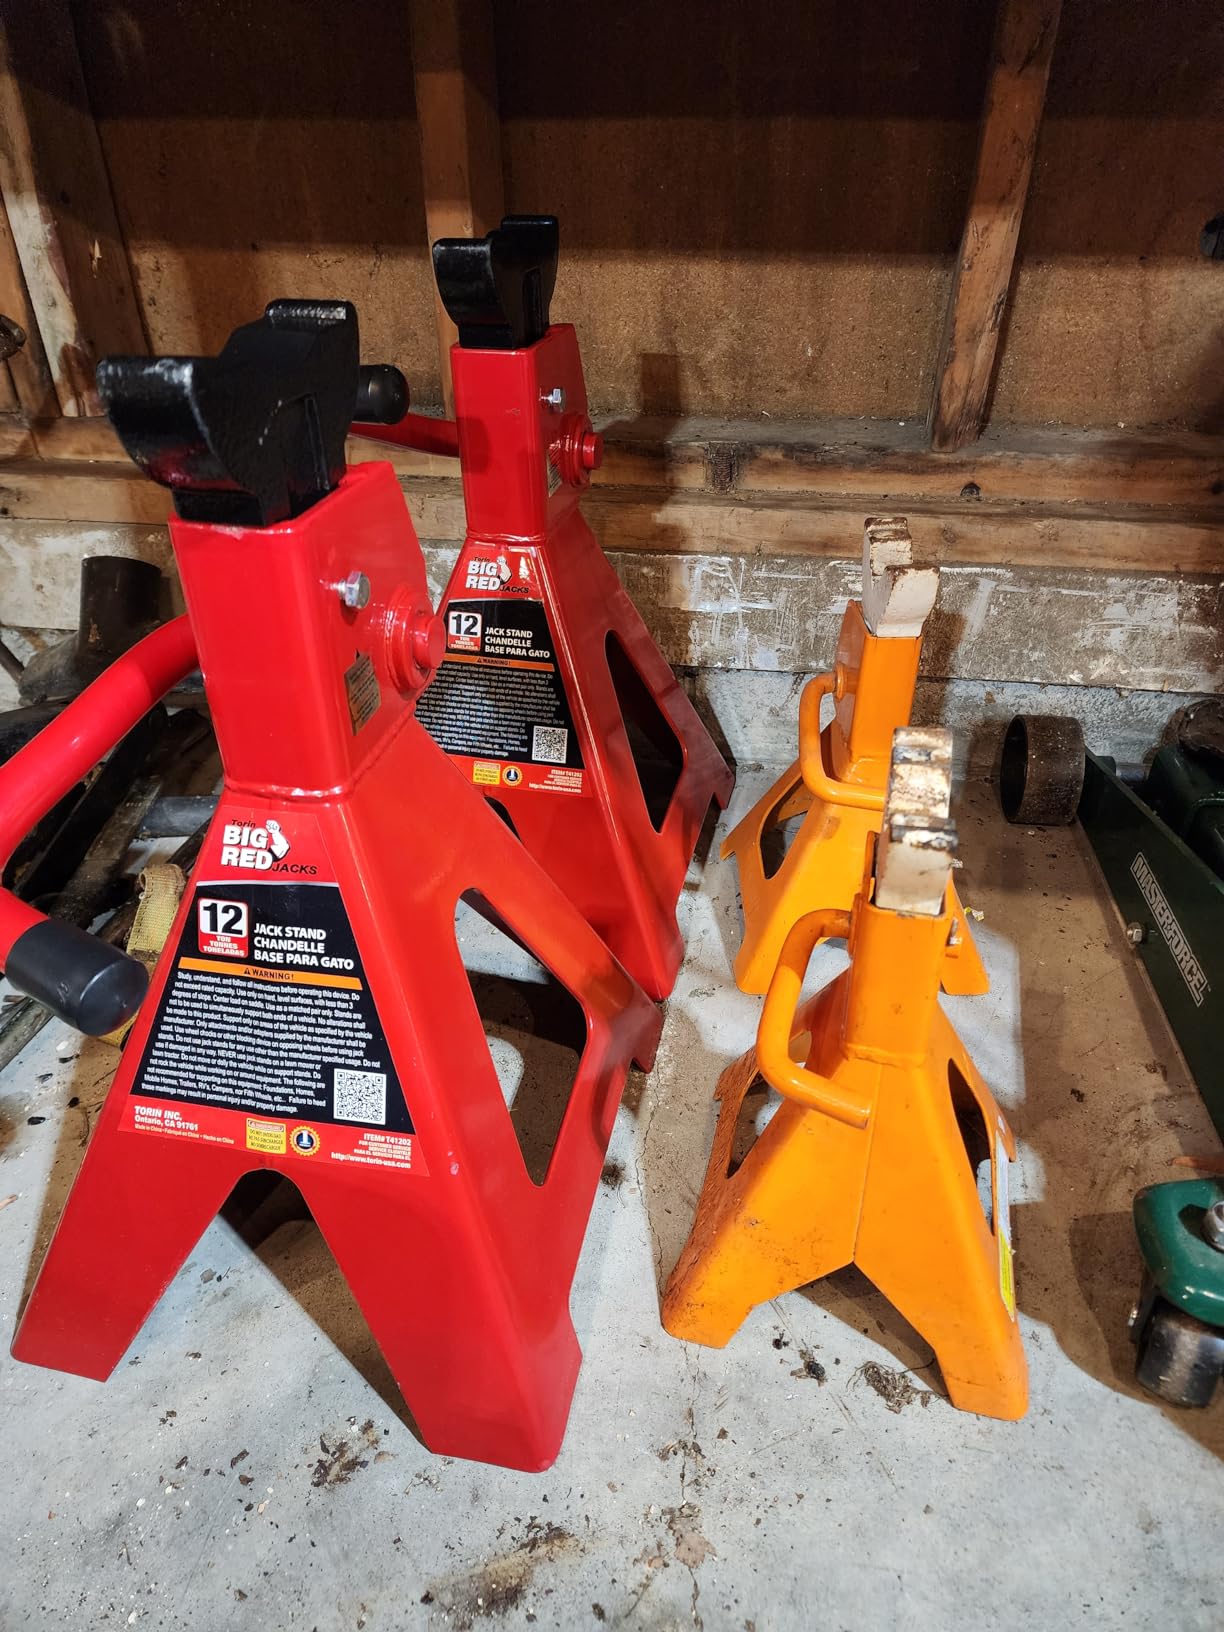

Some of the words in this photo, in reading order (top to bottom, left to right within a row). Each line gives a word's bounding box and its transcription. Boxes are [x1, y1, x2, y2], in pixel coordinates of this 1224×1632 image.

[468, 560, 498, 576] BIG
[466, 576, 501, 591] RED
[452, 614, 478, 636] 12
[485, 626, 505, 636] JACK
[506, 629, 533, 638] STAND
[485, 636, 532, 648] CHANDELLE
[484, 645, 505, 654] BASE
[506, 648, 526, 656] PARA
[528, 650, 550, 658] GATO
[231, 819, 256, 828] Torin
[223, 825, 268, 850] BIG
[221, 846, 273, 870] RED
[272, 864, 318, 875] JACKS
[203, 902, 243, 936] 12
[254, 922, 283, 936] JACK
[284, 926, 326, 940] STAND
[1133, 856, 1206, 1003] MASTERFORCE
[203, 946, 244, 956] TONELADAS
[210, 940, 238, 950] TONNES
[254, 936, 325, 954] CHANDELLE
[254, 950, 284, 964] BASE
[286, 954, 318, 966] PARA
[320, 956, 354, 970] GATO
[252, 968, 294, 980] WARNING!
[134, 1106, 162, 1117] TORIN
[164, 1109, 182, 1121] INC.
[134, 1115, 164, 1126] Ontario,
[164, 1120, 175, 1128] CA
[364, 1132, 385, 1143] ITEM#
[386, 1136, 412, 1146] T41202
